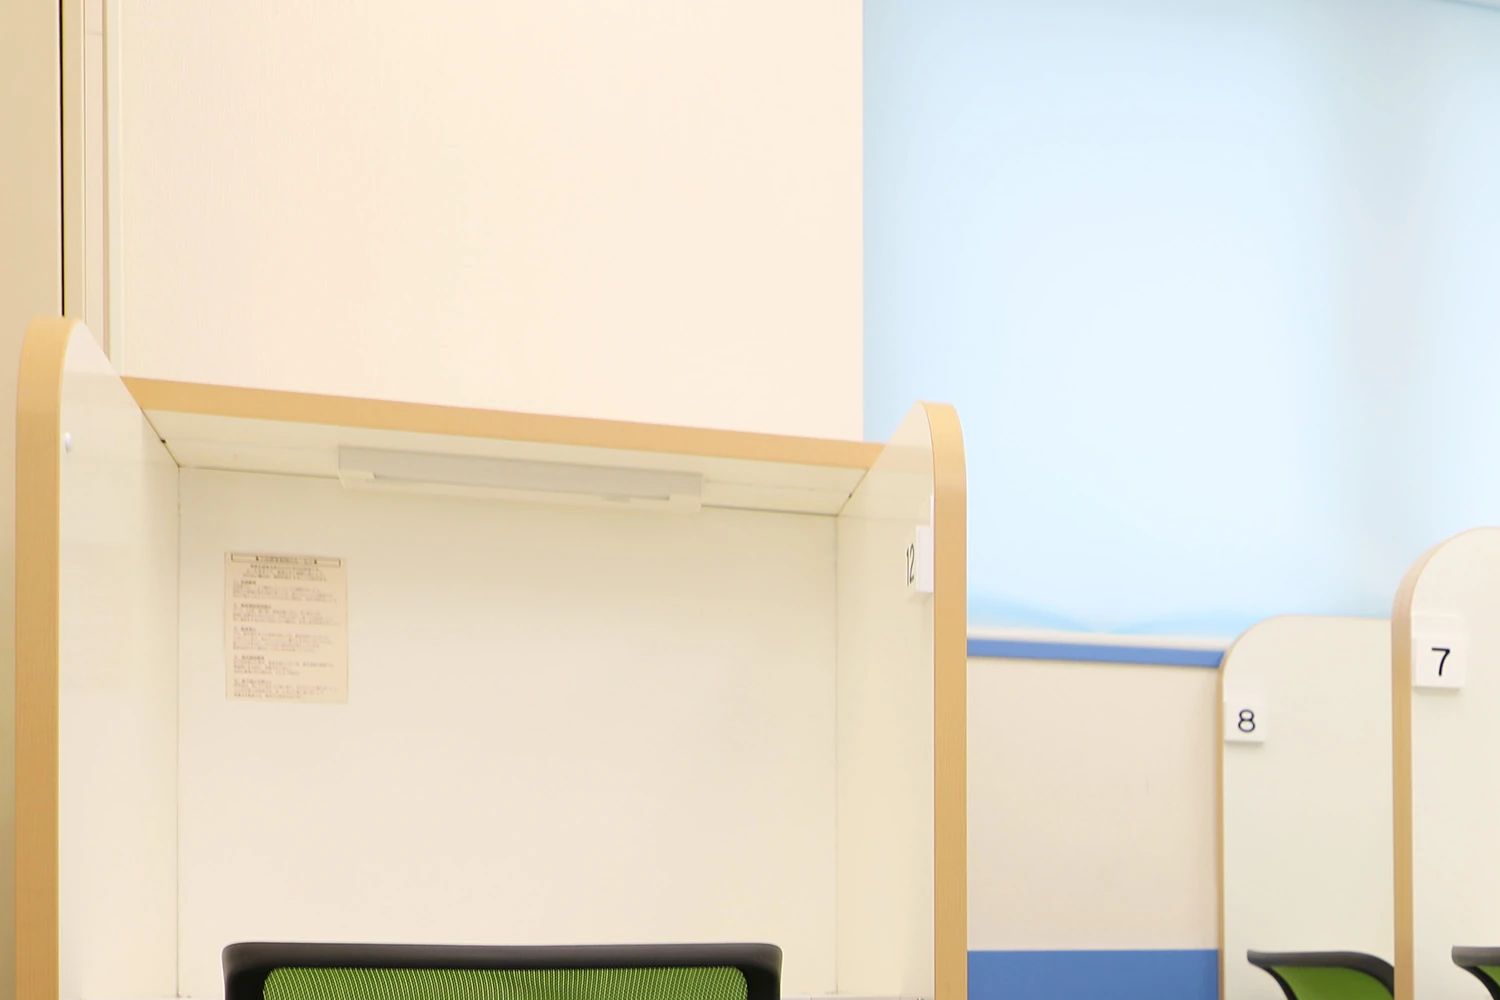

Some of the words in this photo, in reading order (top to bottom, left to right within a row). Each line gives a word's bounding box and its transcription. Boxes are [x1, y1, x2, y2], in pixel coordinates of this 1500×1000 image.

[906, 543, 915, 587] 12
[1431, 647, 1451, 676] 7
[1237, 708, 1256, 733] 8
